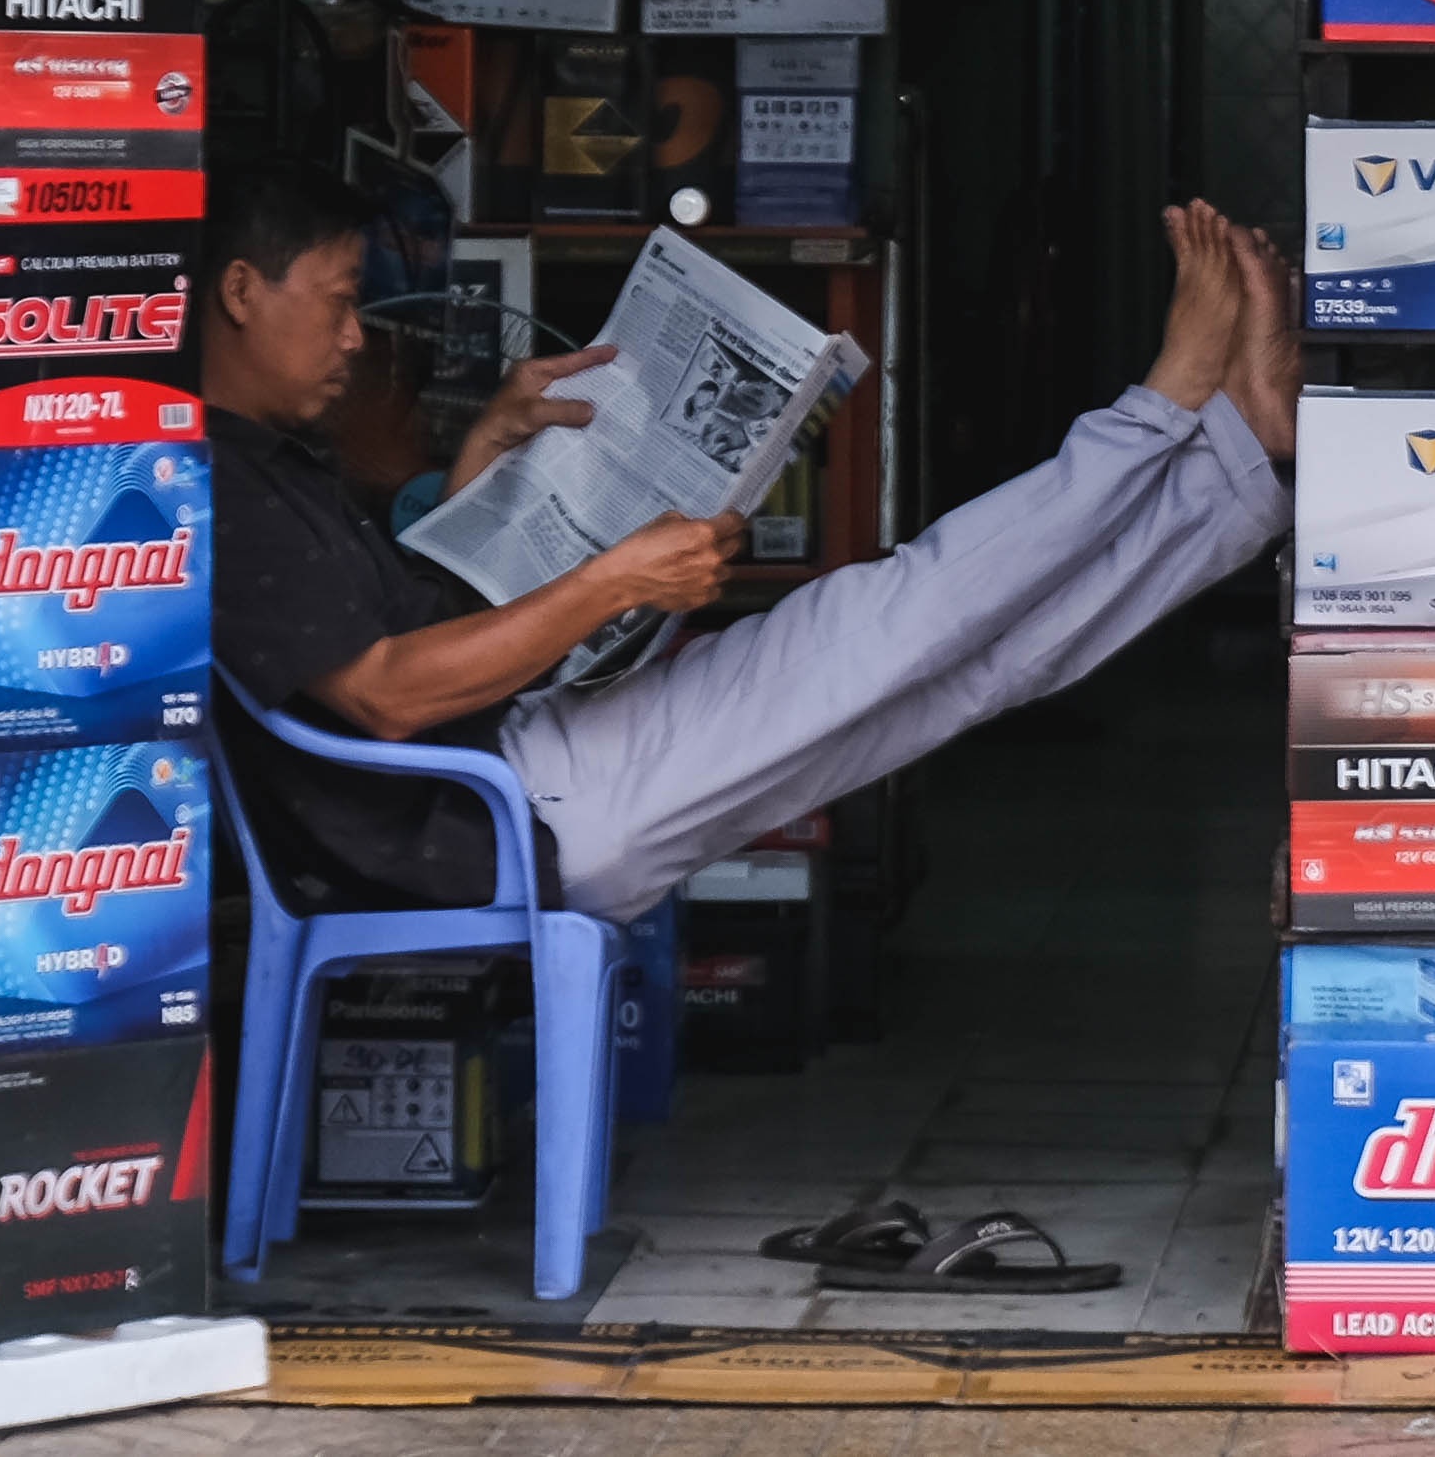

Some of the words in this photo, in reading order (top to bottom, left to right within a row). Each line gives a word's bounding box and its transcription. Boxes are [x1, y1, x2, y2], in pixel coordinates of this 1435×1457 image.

[25, 181, 132, 214] 105D31L
[1314, 300, 1365, 315] 57539
[23, 392, 125, 422] NX120-7L
[163, 705, 200, 727] N70
[1333, 1313, 1394, 1336] LEAD
